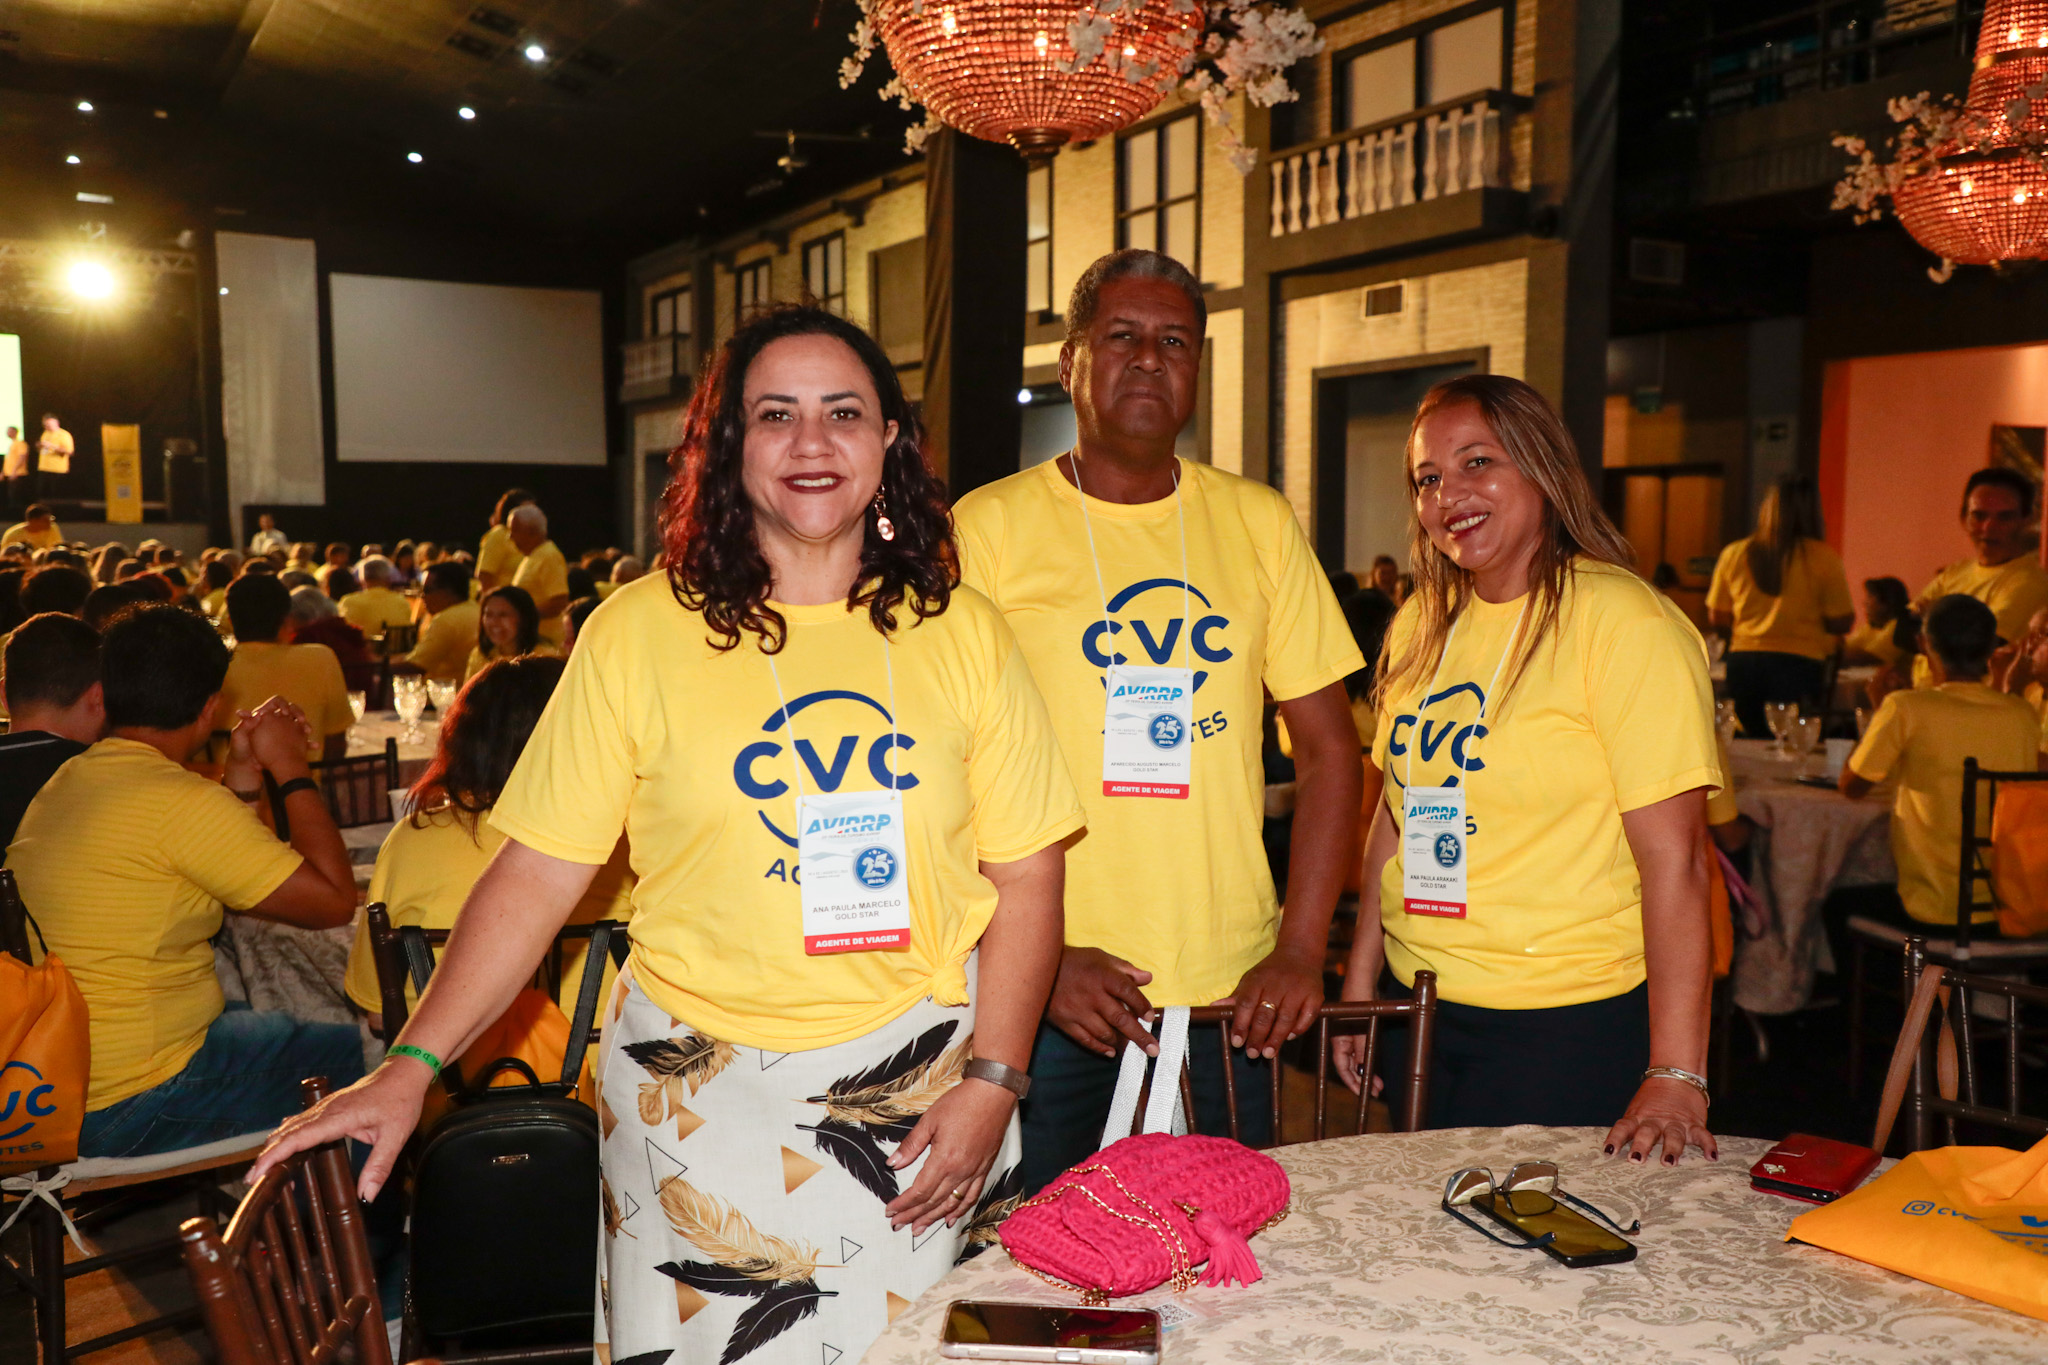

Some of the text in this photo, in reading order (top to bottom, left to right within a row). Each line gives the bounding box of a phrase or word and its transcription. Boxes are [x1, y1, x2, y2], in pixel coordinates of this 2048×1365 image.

[1082, 615, 1234, 668] CVC
[1112, 685, 1183, 701] AVIRRP
[1155, 720, 1178, 740] 25
[1389, 714, 1489, 771] CVC
[733, 733, 920, 800] CVC
[1408, 806, 1458, 820] AVIRRP
[805, 814, 891, 835] AVIRRP
[862, 853, 890, 879] 25
[859, 900, 901, 909] MARCELO
[816, 934, 900, 948] AGENTE DE VIAGEM
